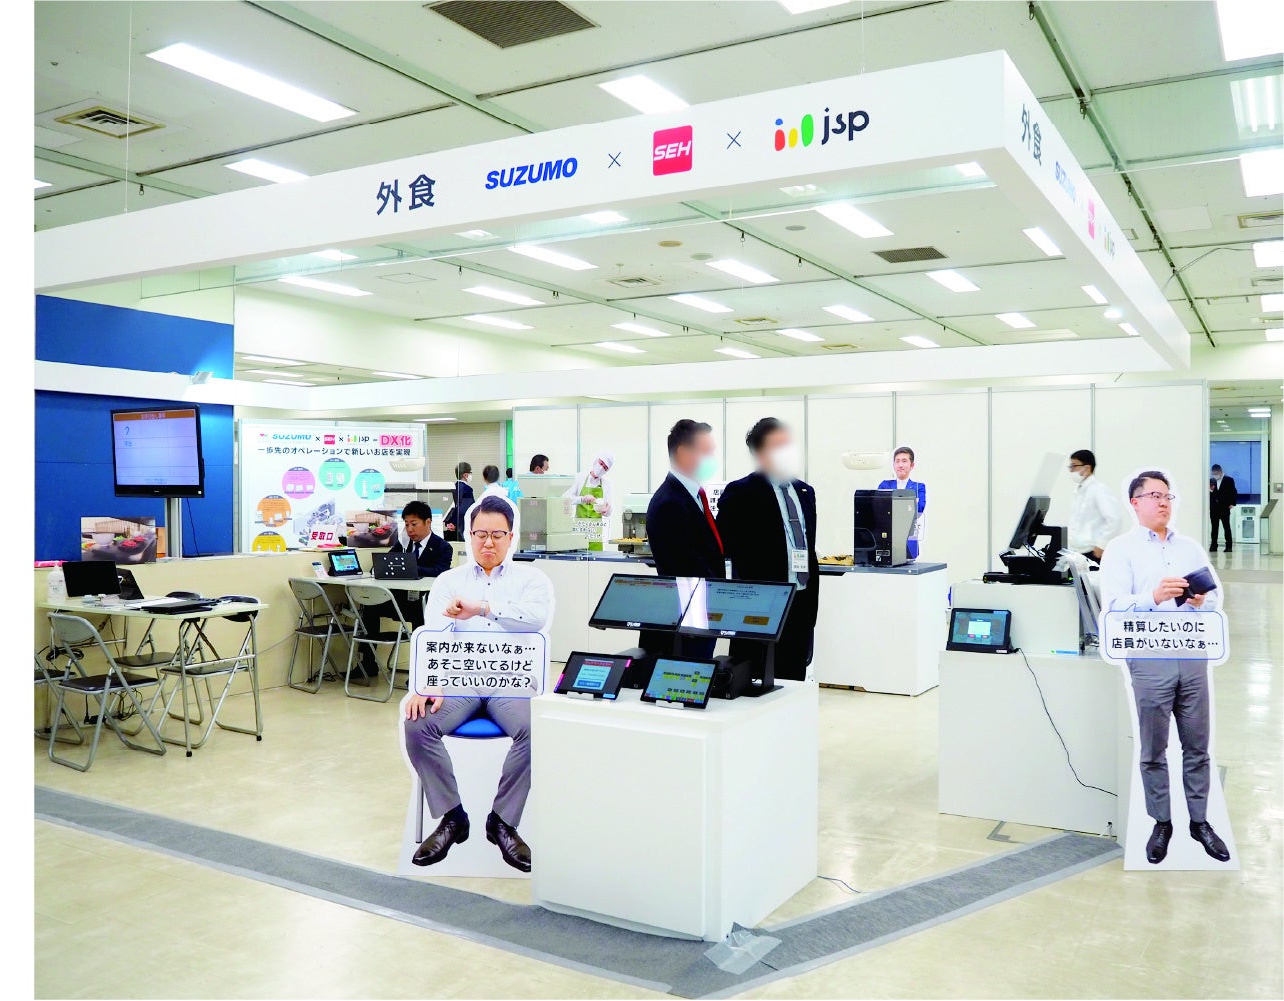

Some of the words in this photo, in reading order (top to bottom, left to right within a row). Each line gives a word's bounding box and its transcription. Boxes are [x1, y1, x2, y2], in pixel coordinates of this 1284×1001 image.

[1021, 104, 1042, 166] 外食
[376, 174, 436, 216] 外食
[485, 157, 578, 190] SUZUMO
[654, 140, 691, 161] SEH
[821, 107, 870, 145] jsp
[381, 435, 412, 446] DX化
[1123, 621, 1205, 633] 精算したいのに
[426, 641, 536, 655] 案内が来ないなぁ…
[1112, 637, 1218, 649] 店員がいないなぁ…
[427, 658, 533, 672] あそこ空いてるけど
[426, 675, 531, 688] 座っていいのかな?
